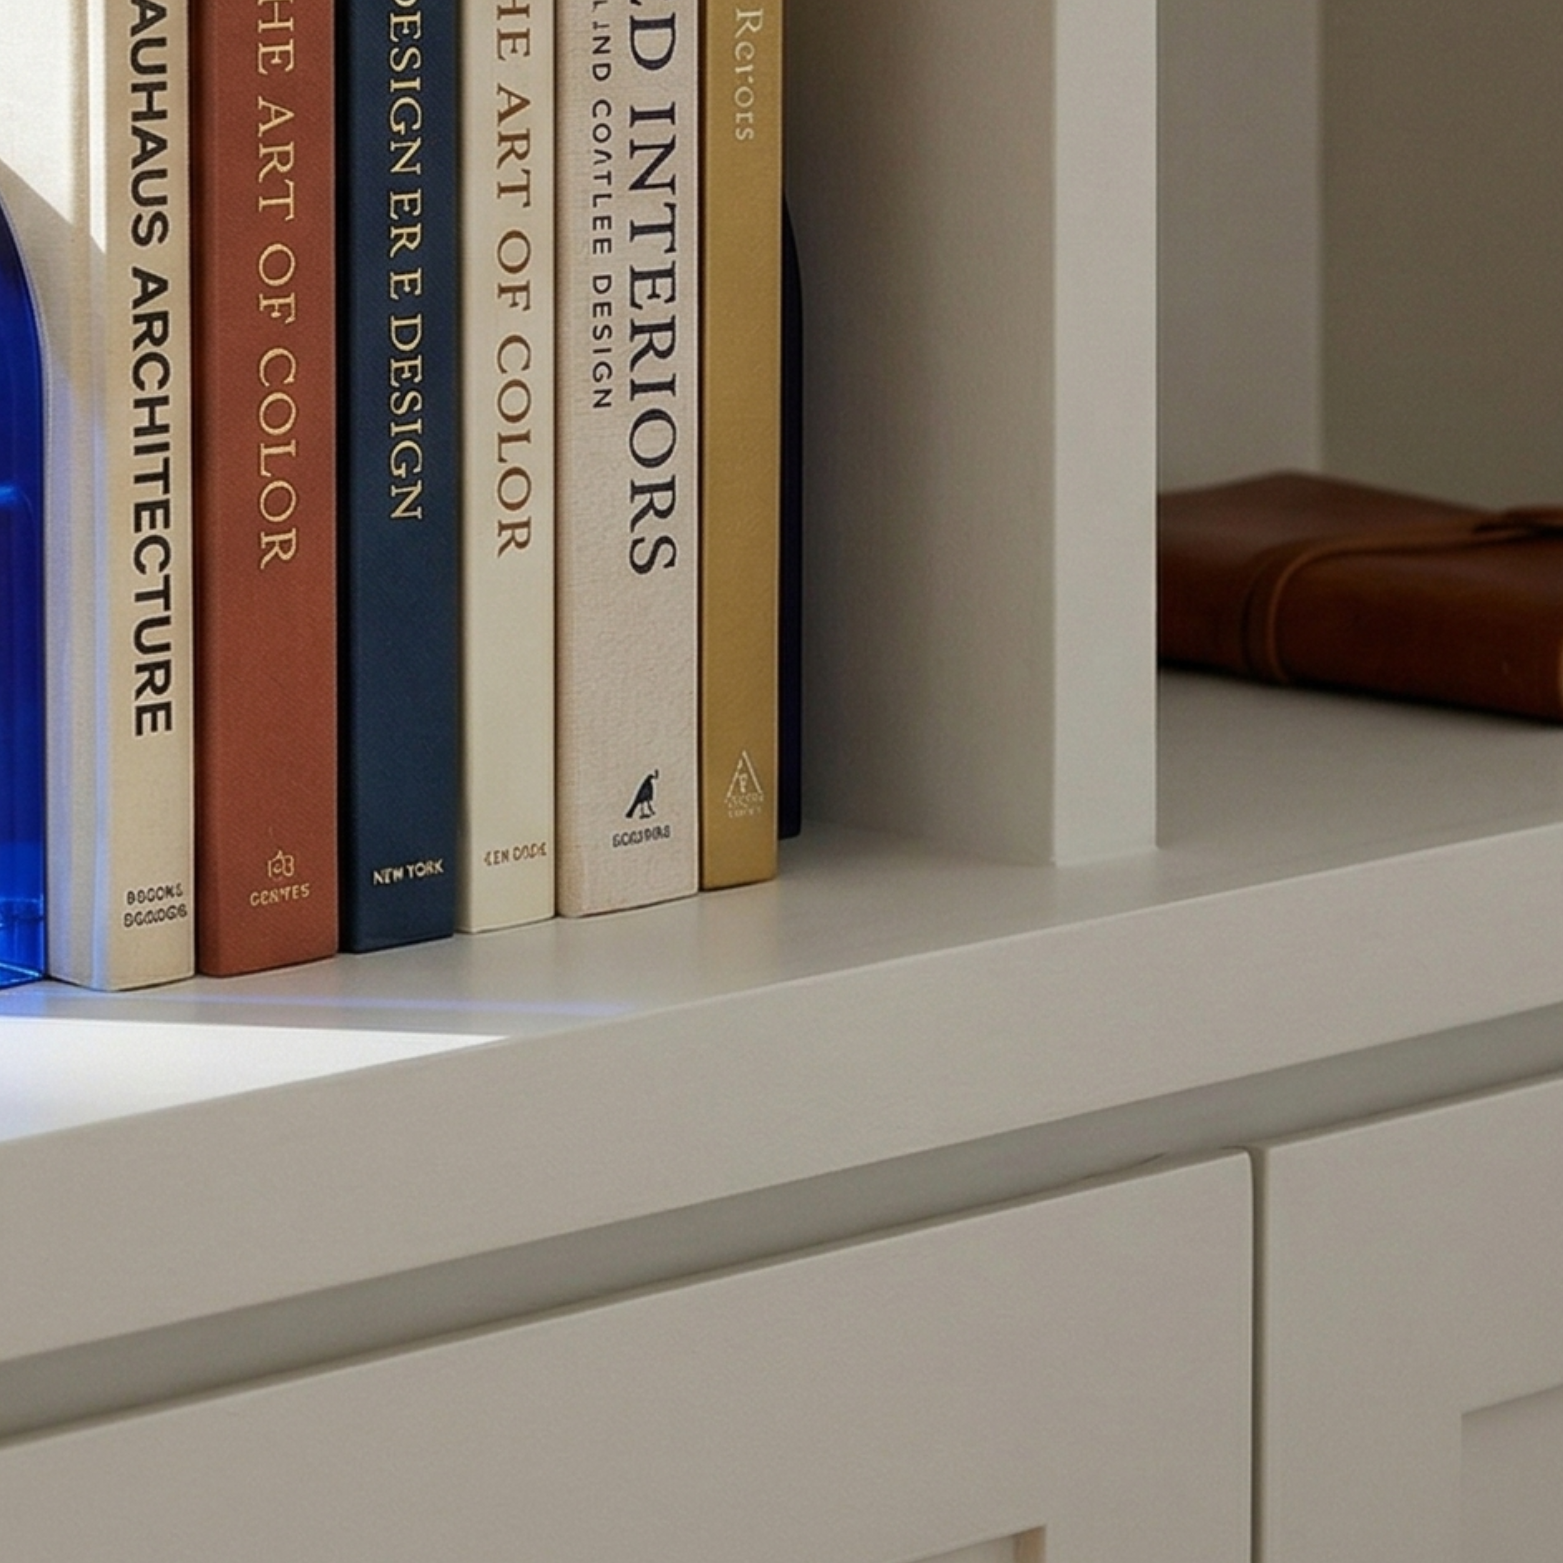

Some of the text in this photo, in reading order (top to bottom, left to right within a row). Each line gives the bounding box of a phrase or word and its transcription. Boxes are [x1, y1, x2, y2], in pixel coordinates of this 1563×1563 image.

[257, 95, 296, 222] ART
[495, 83, 532, 209] ART
[257, 243, 297, 325] OF
[496, 230, 532, 313] OF
[591, 274, 614, 410] DESIGN
[628, 101, 678, 575] INTERIORS
[130, 265, 173, 737] ARCHITECTURE
[258, 347, 298, 570] COLOR
[389, 312, 423, 520] DESIGN
[496, 335, 533, 557] COLOR
